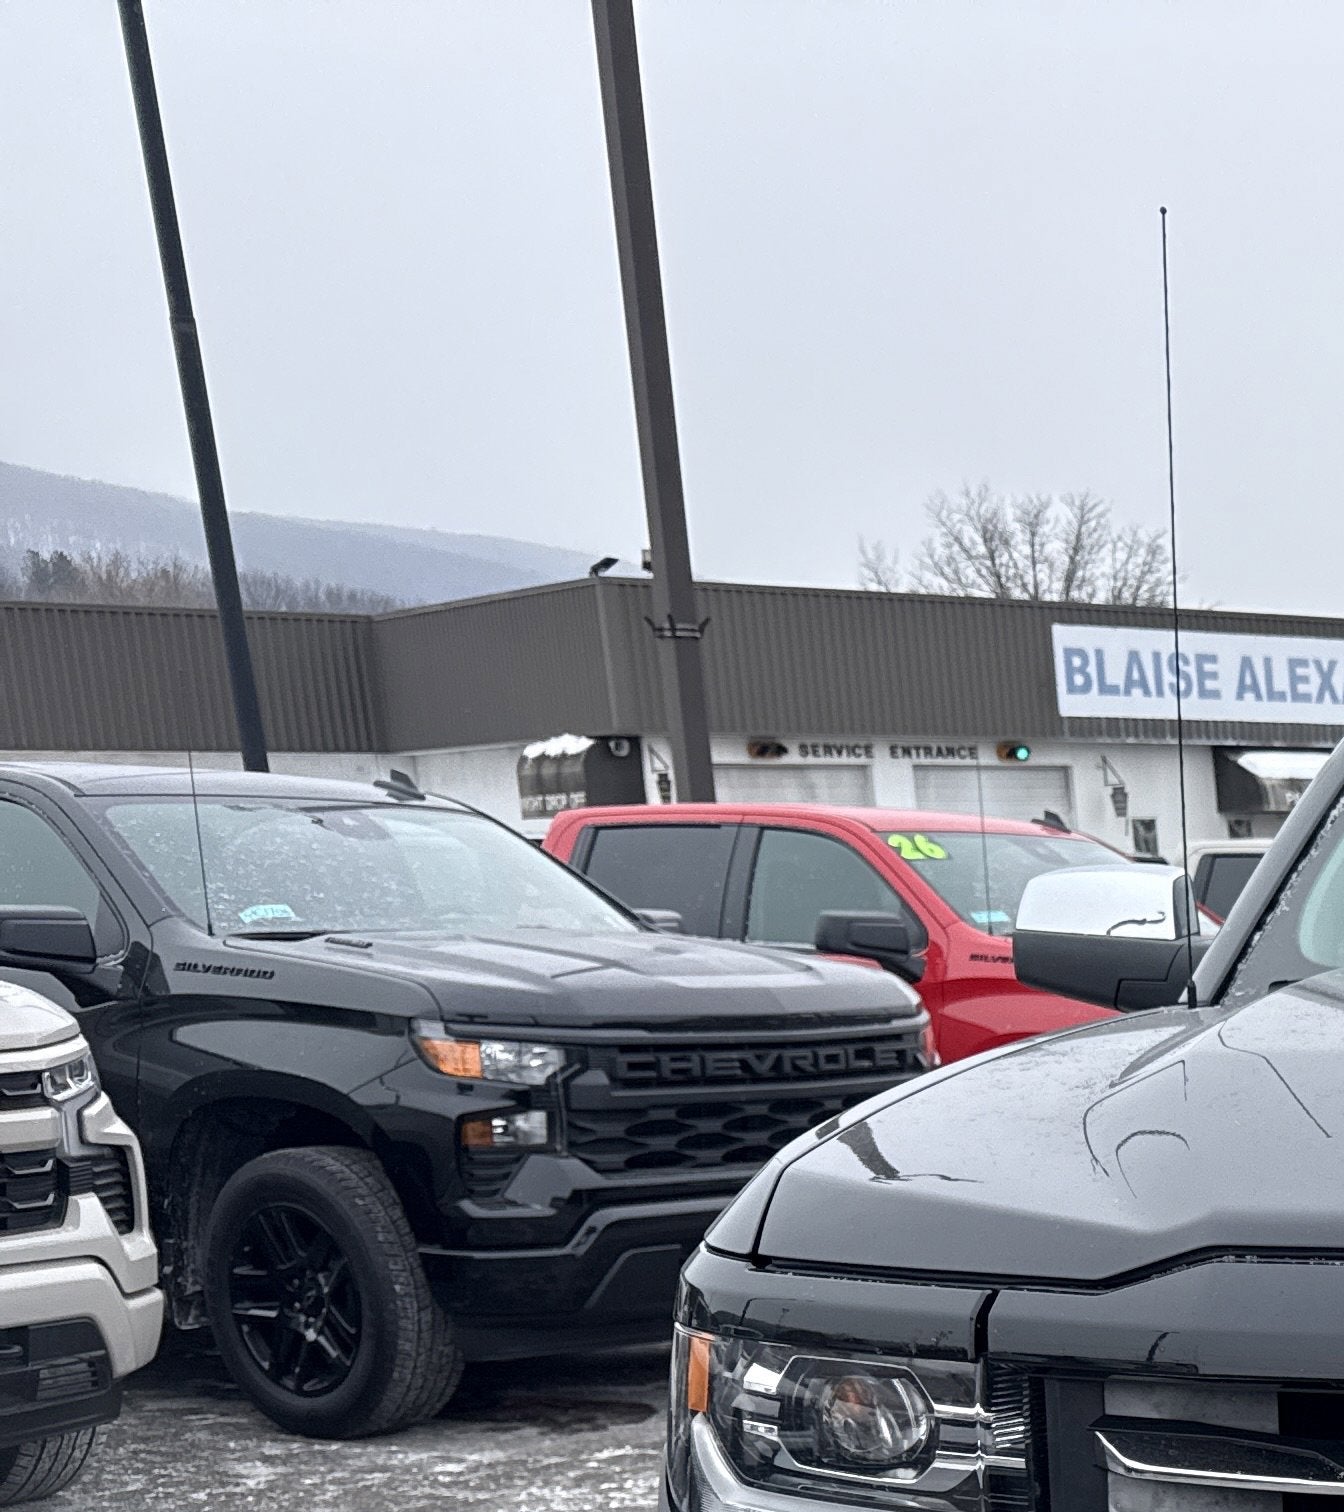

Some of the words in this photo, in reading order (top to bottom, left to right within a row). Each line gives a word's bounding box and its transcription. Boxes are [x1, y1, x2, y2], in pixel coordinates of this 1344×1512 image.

[1062, 646, 1222, 700] BLAISE
[799, 743, 874, 759] SERVICE
[889, 744, 978, 760] ENTRANCE
[888, 833, 949, 861] 26
[174, 961, 275, 981] SILVERADO
